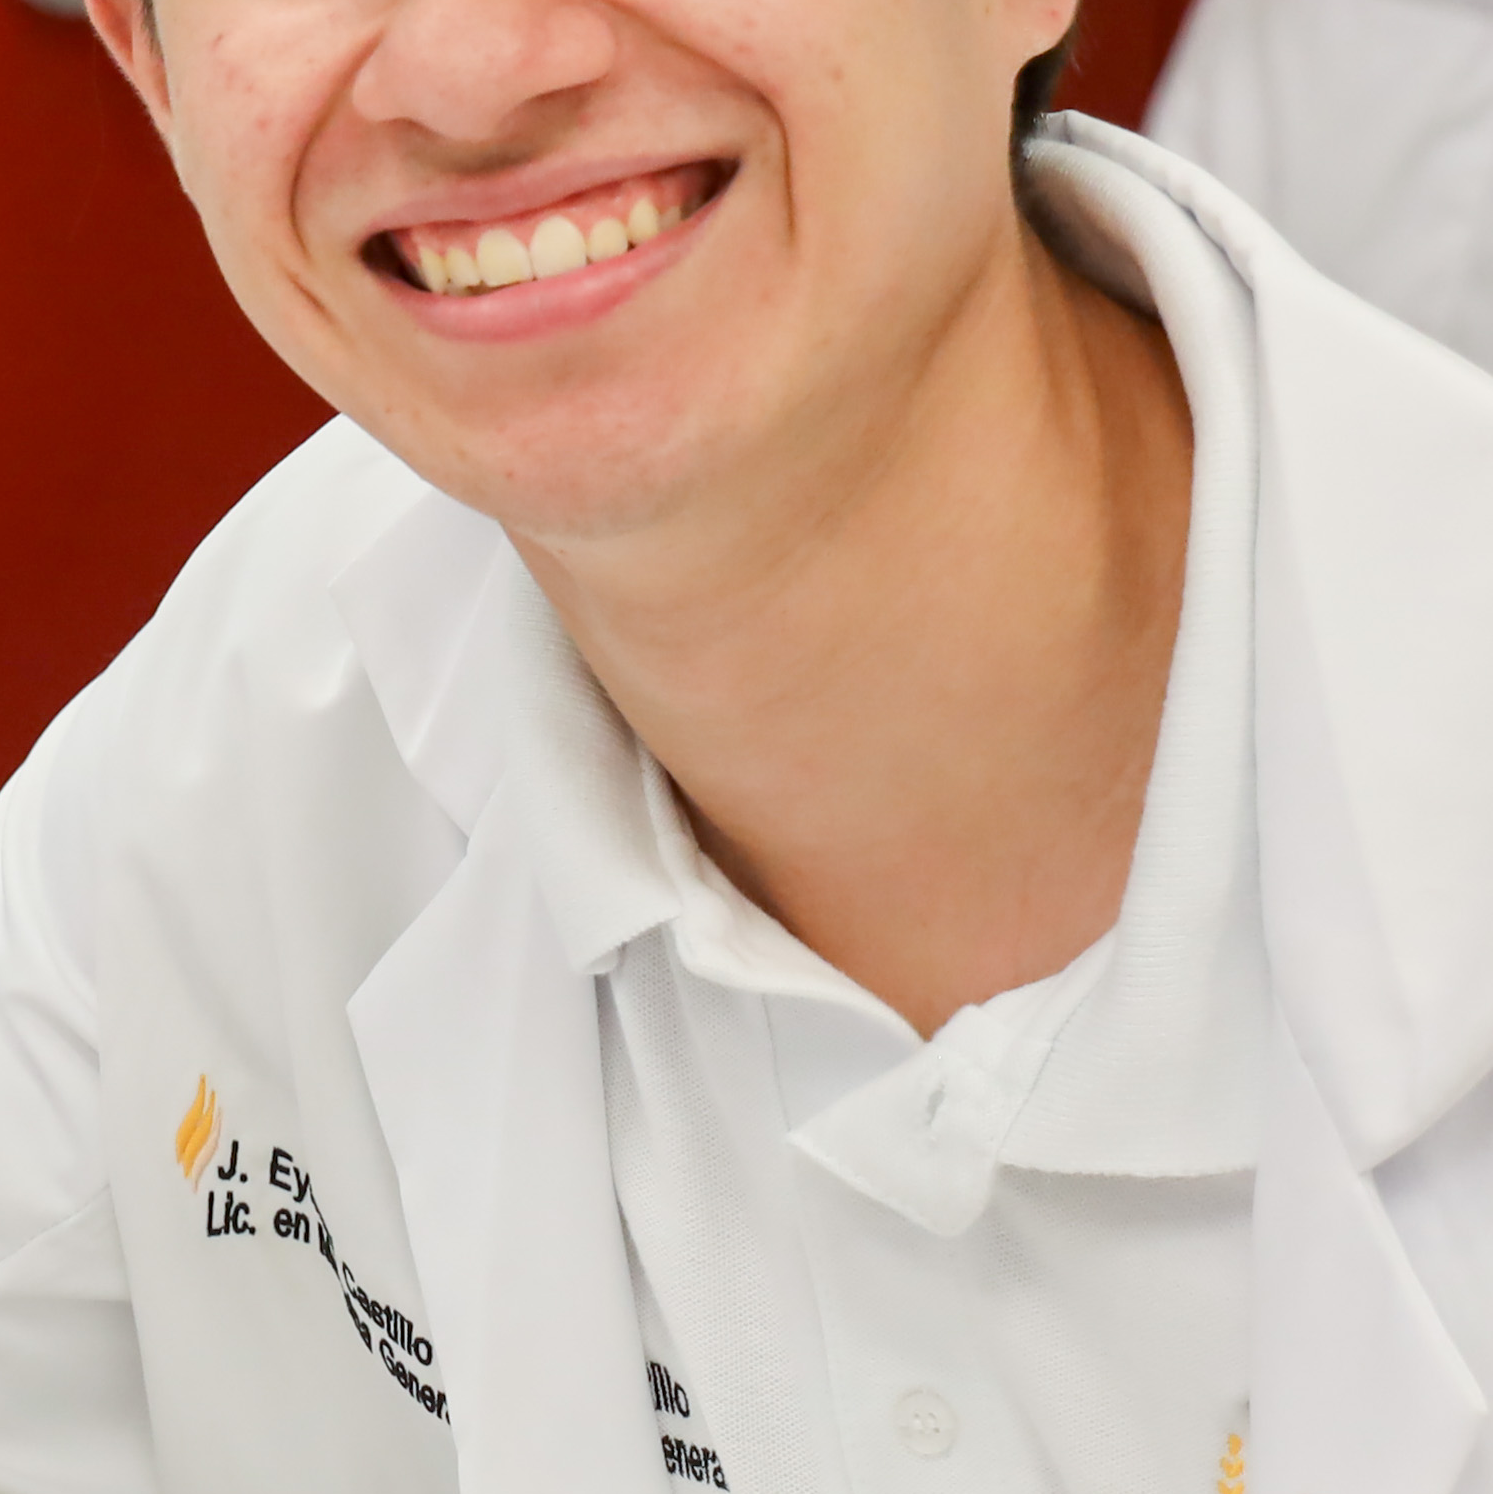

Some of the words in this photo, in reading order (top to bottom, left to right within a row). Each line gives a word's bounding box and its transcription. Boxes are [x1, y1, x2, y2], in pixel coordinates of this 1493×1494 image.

[207, 1191, 256, 1237] Lic.
[274, 1207, 310, 1243] en
[379, 1338, 451, 1425] Gener
[217, 1140, 248, 1182] J.
[342, 1261, 433, 1366] Castillo
